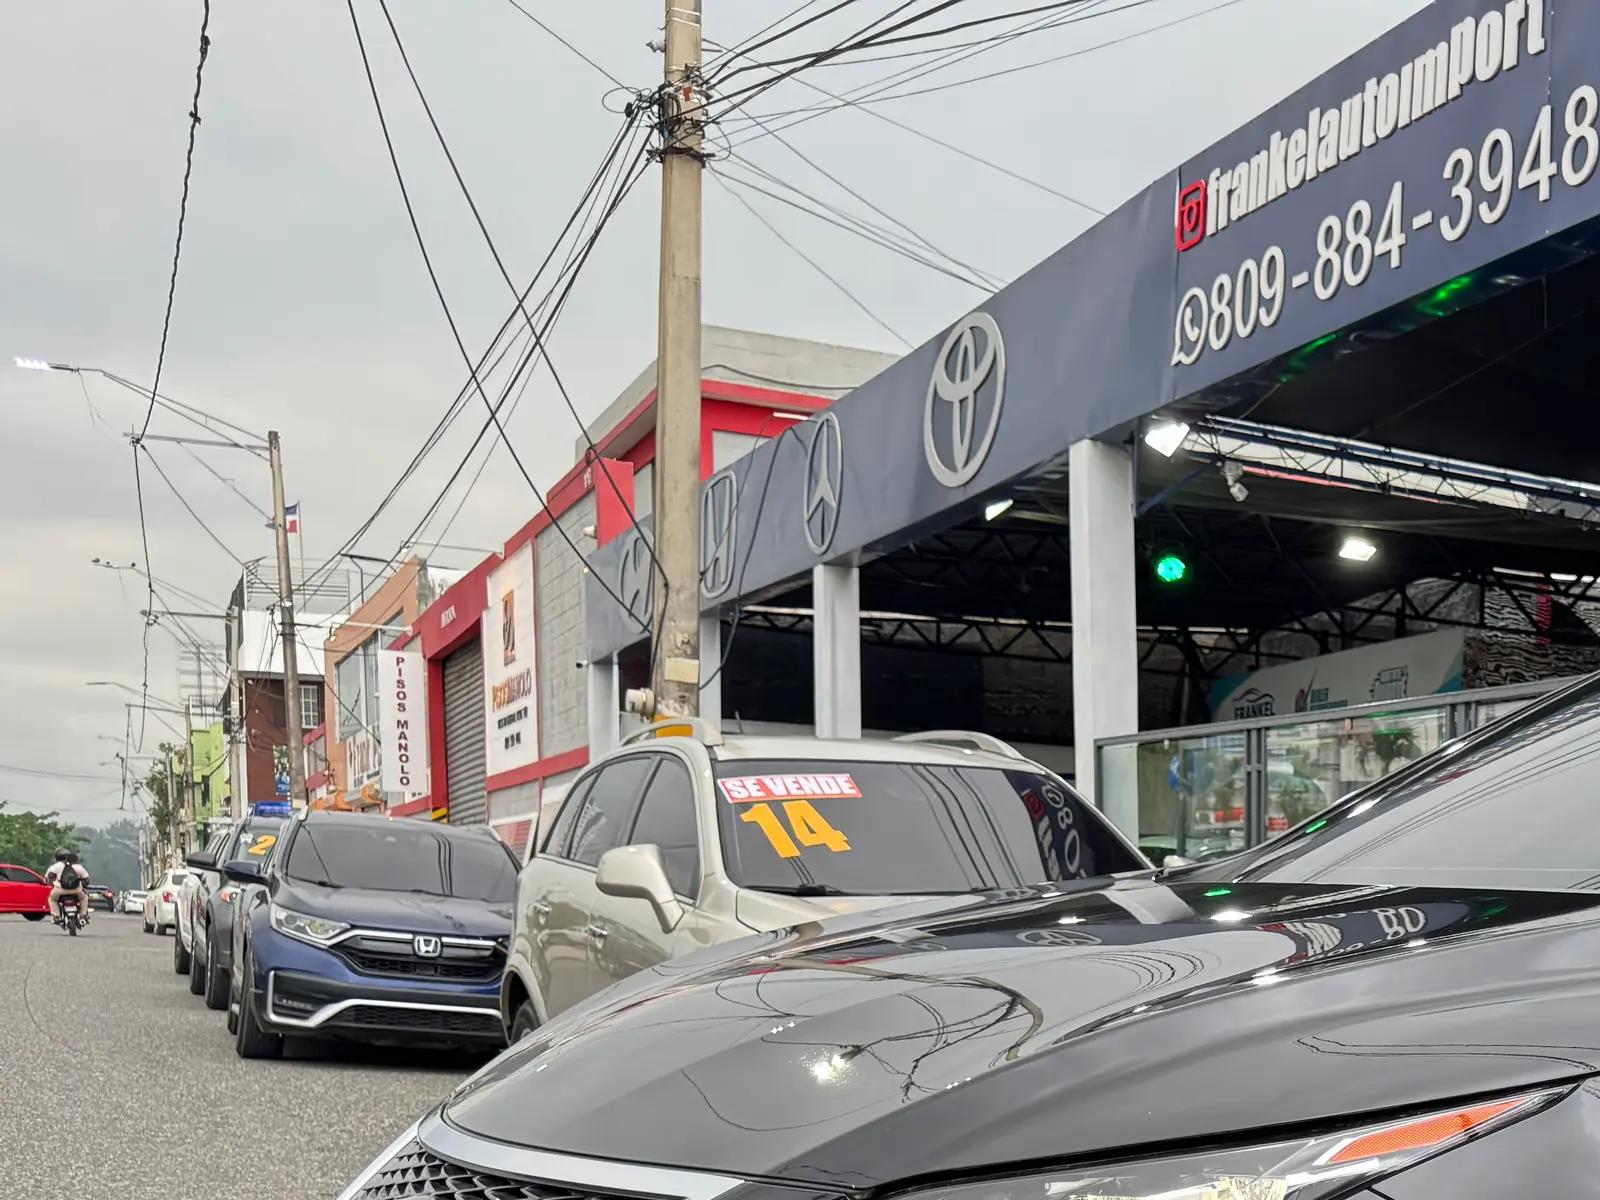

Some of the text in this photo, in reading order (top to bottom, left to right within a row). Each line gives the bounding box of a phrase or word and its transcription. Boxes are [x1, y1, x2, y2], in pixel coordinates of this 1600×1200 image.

[1207, 84, 1599, 351] 809-884-3948
[396, 656, 410, 786] PISOS MANOLO
[725, 775, 857, 799] SE VENDE
